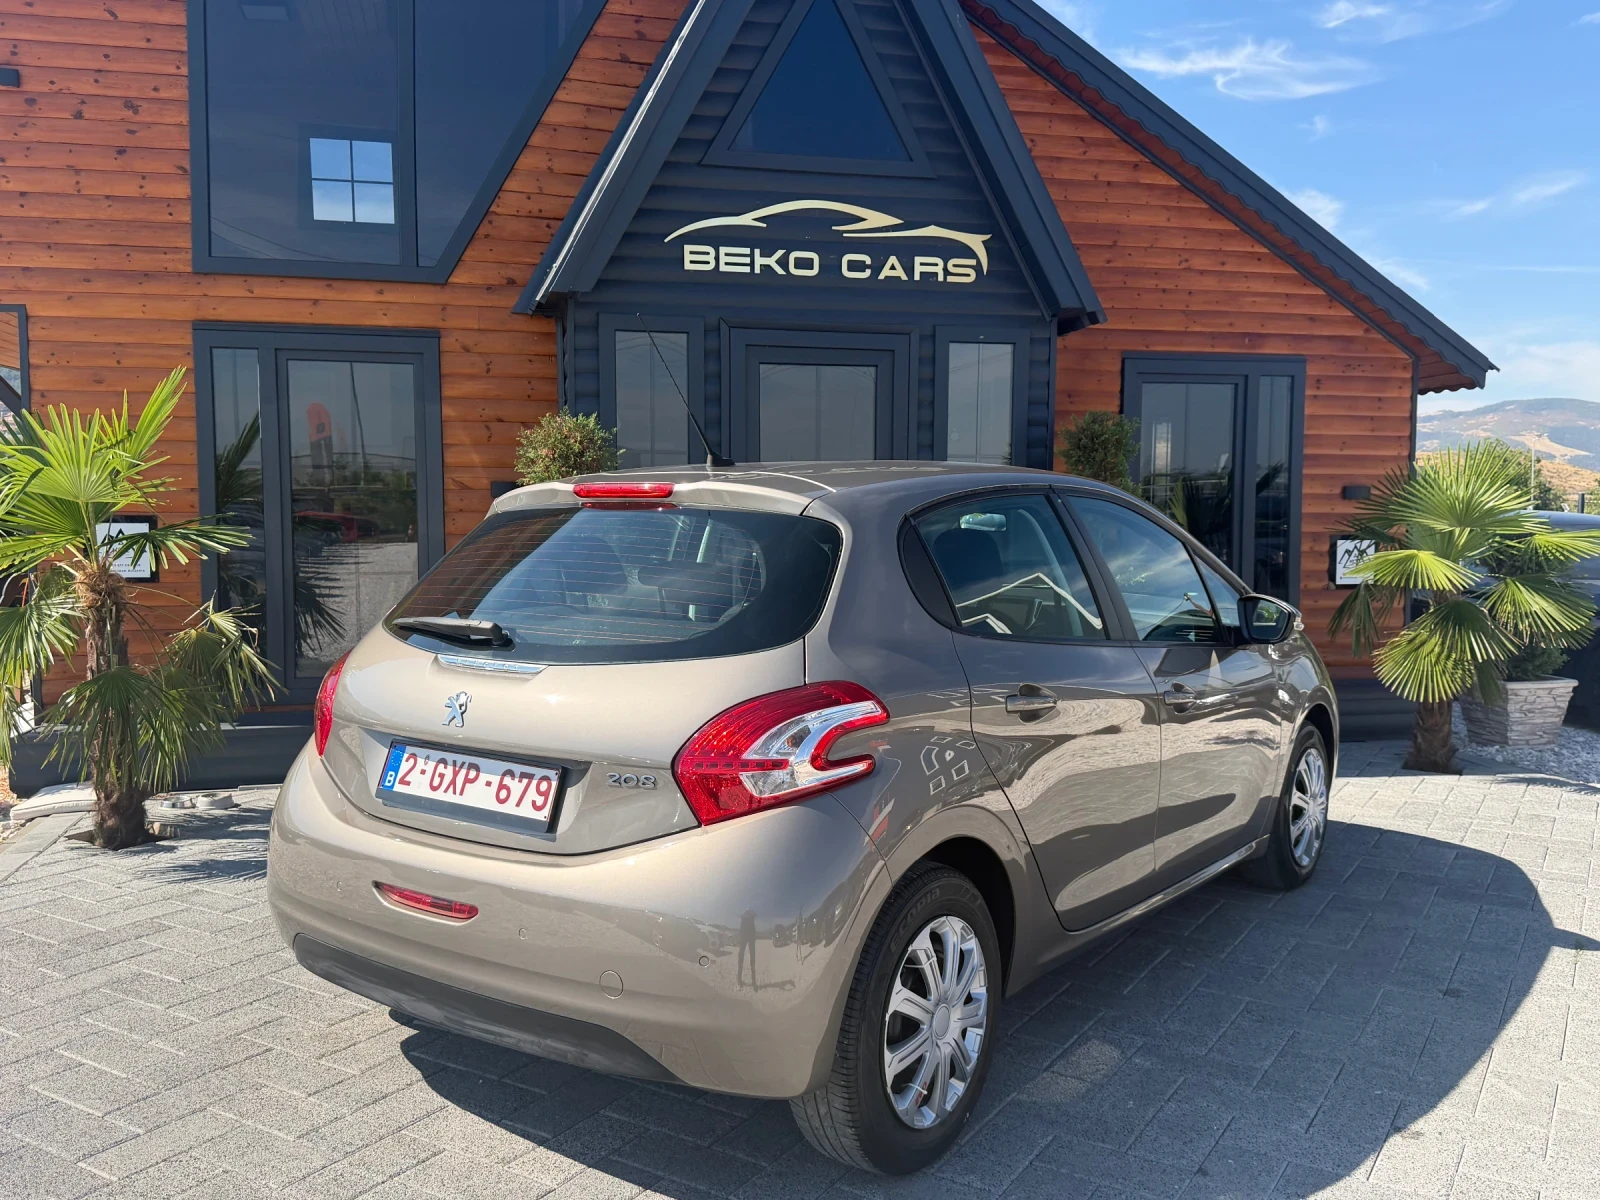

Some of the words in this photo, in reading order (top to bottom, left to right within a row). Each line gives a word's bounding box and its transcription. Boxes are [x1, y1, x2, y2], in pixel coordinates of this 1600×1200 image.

[683, 244, 820, 277] BEKO
[841, 253, 978, 283] CARS
[384, 771, 395, 787] B
[397, 752, 553, 812] 2-GXP-679
[607, 772, 656, 789] 208
